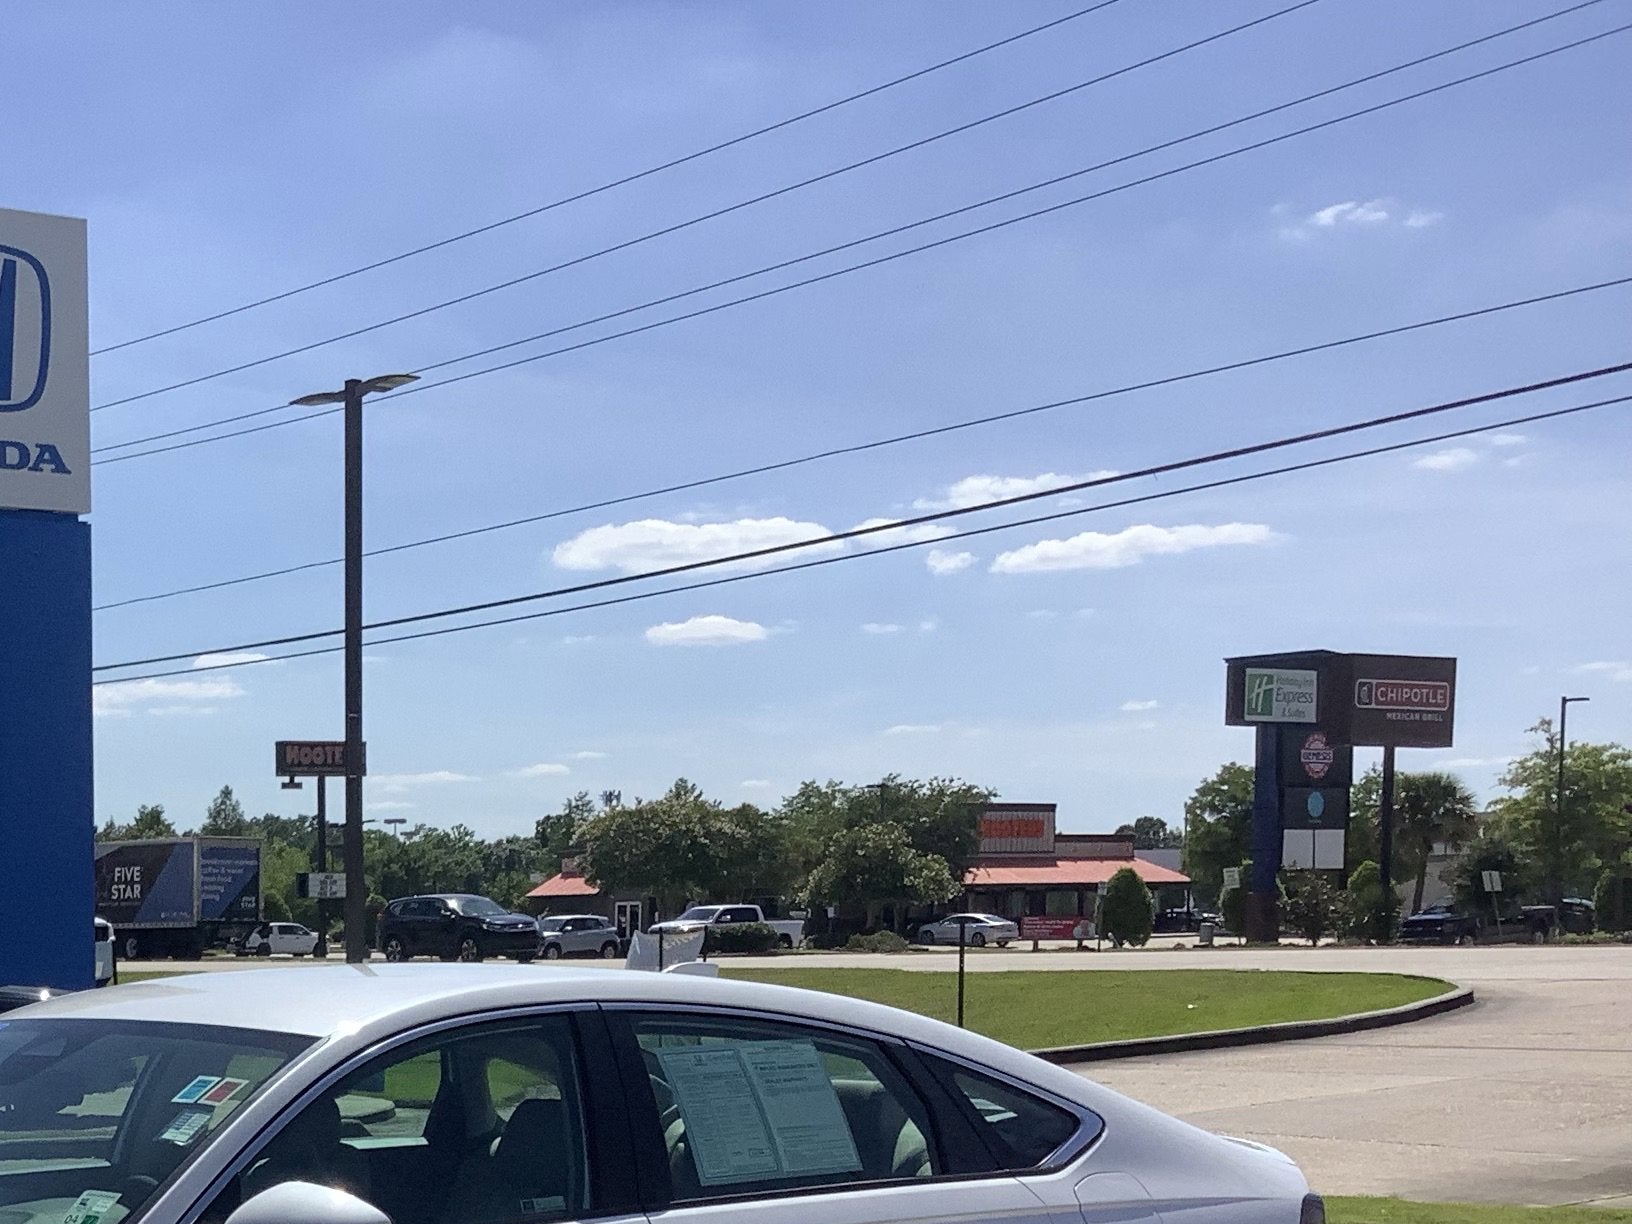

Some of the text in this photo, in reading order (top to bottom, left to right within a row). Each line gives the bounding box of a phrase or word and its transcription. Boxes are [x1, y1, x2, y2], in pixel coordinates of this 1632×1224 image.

[1275, 687, 1314, 706] Express
[1377, 687, 1445, 703] CHIPOTLE
[1386, 712, 1443, 722] MEXICAN GRILL
[285, 745, 345, 765] HOOTE
[114, 866, 141, 882] FIVE
[111, 884, 141, 899] STAR
